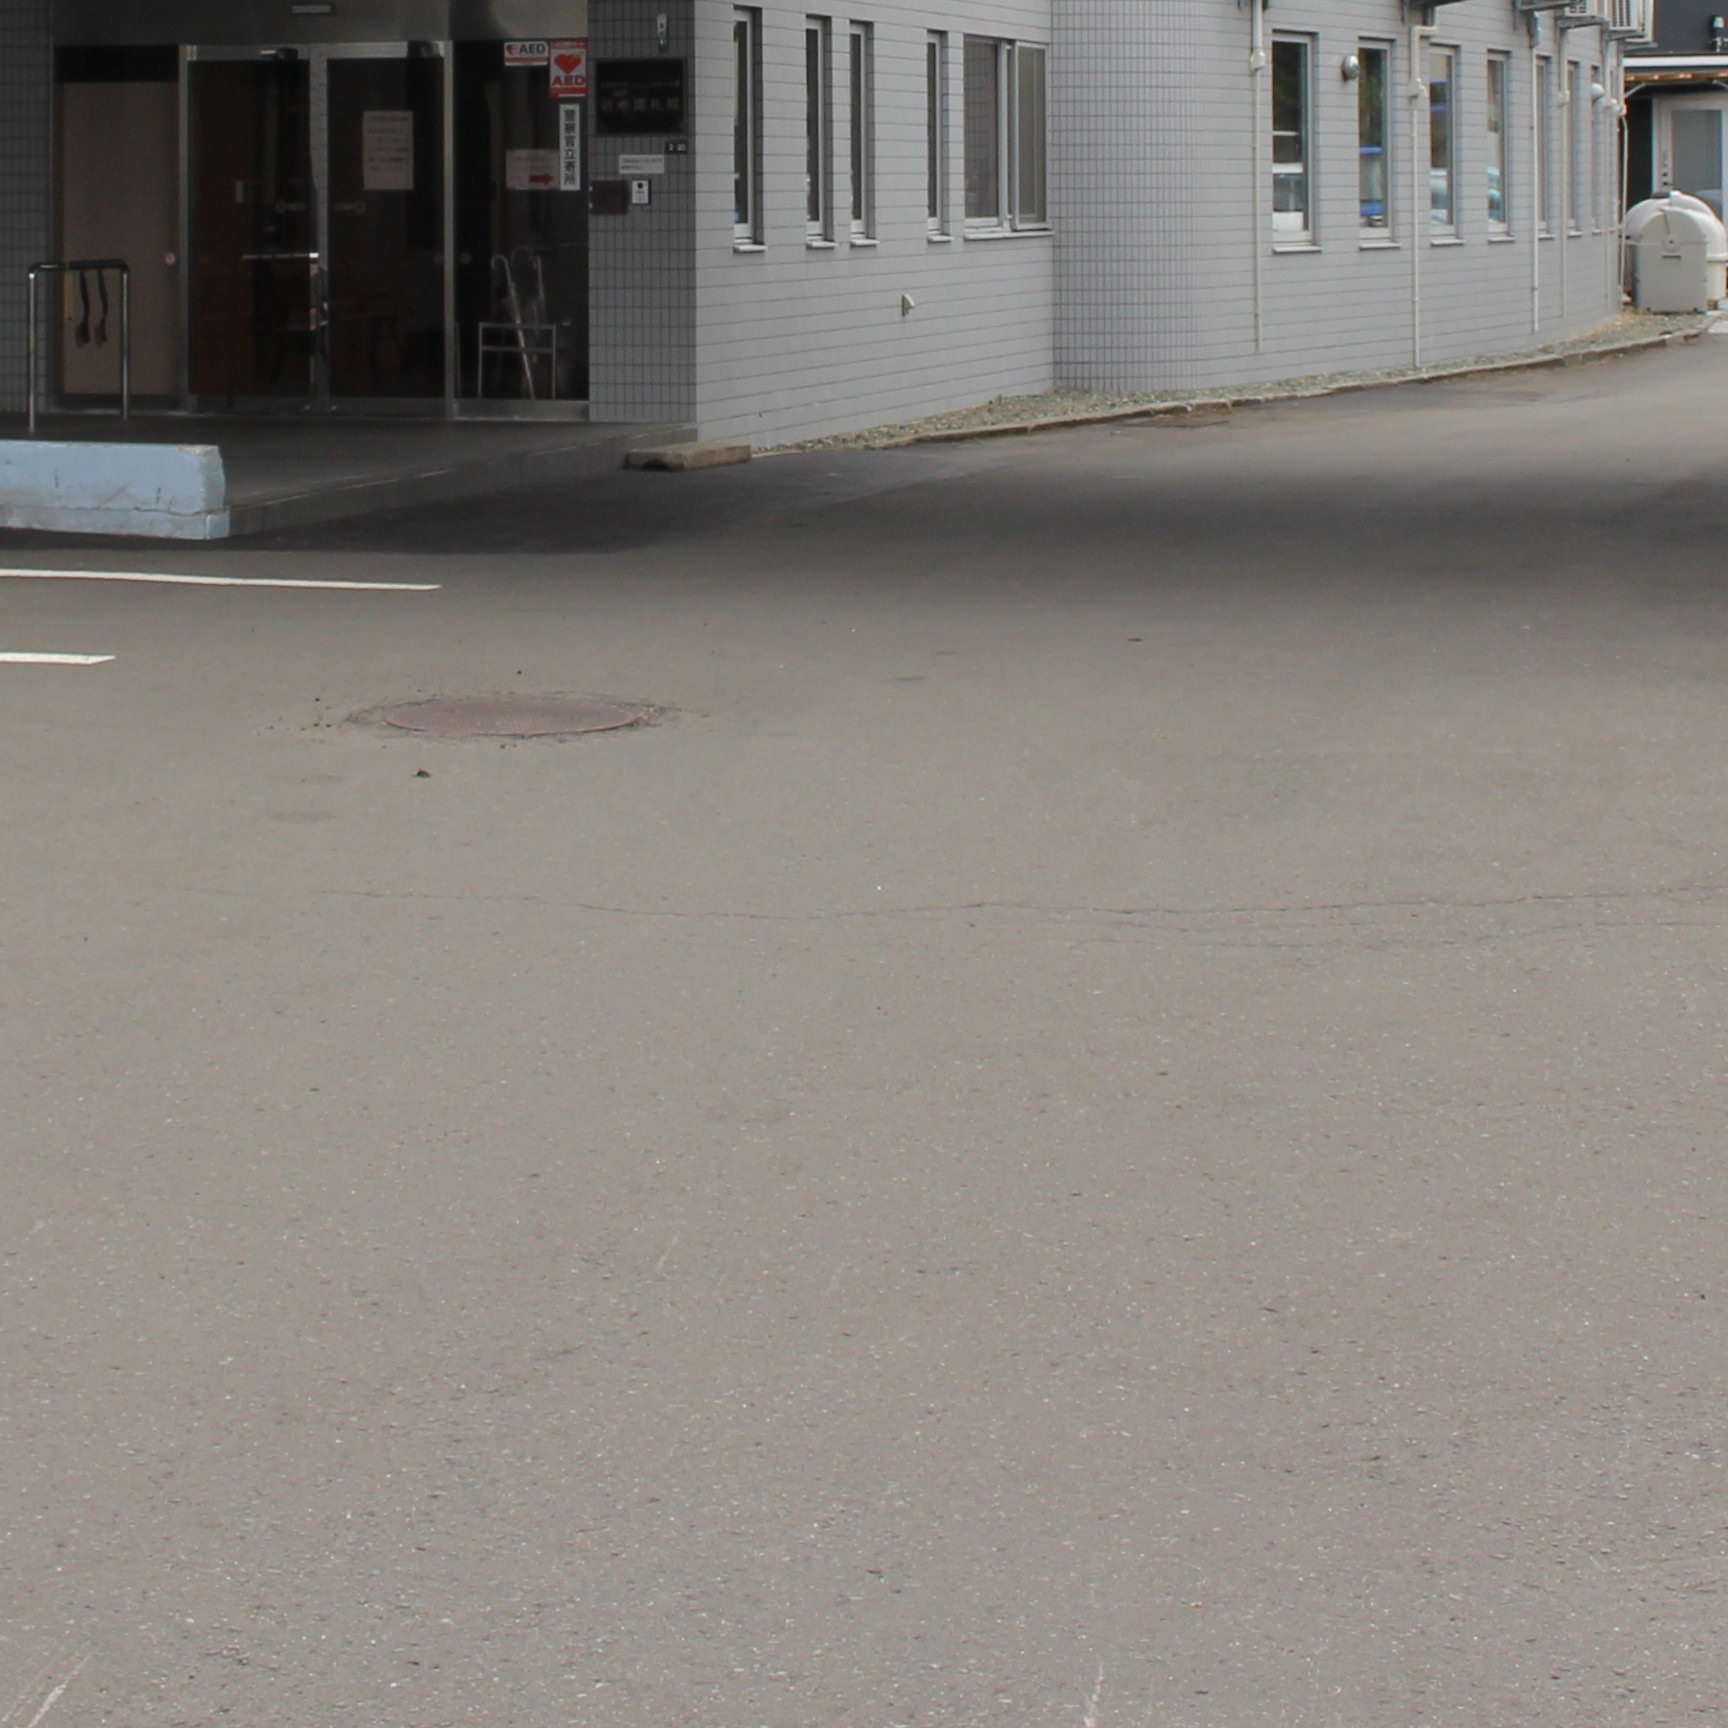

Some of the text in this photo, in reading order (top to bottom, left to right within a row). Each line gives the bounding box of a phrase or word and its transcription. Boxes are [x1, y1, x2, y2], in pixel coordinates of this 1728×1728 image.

[519, 44, 546, 55] AED
[552, 75, 585, 87] AED
[564, 109, 576, 186] 警察官立寄所
